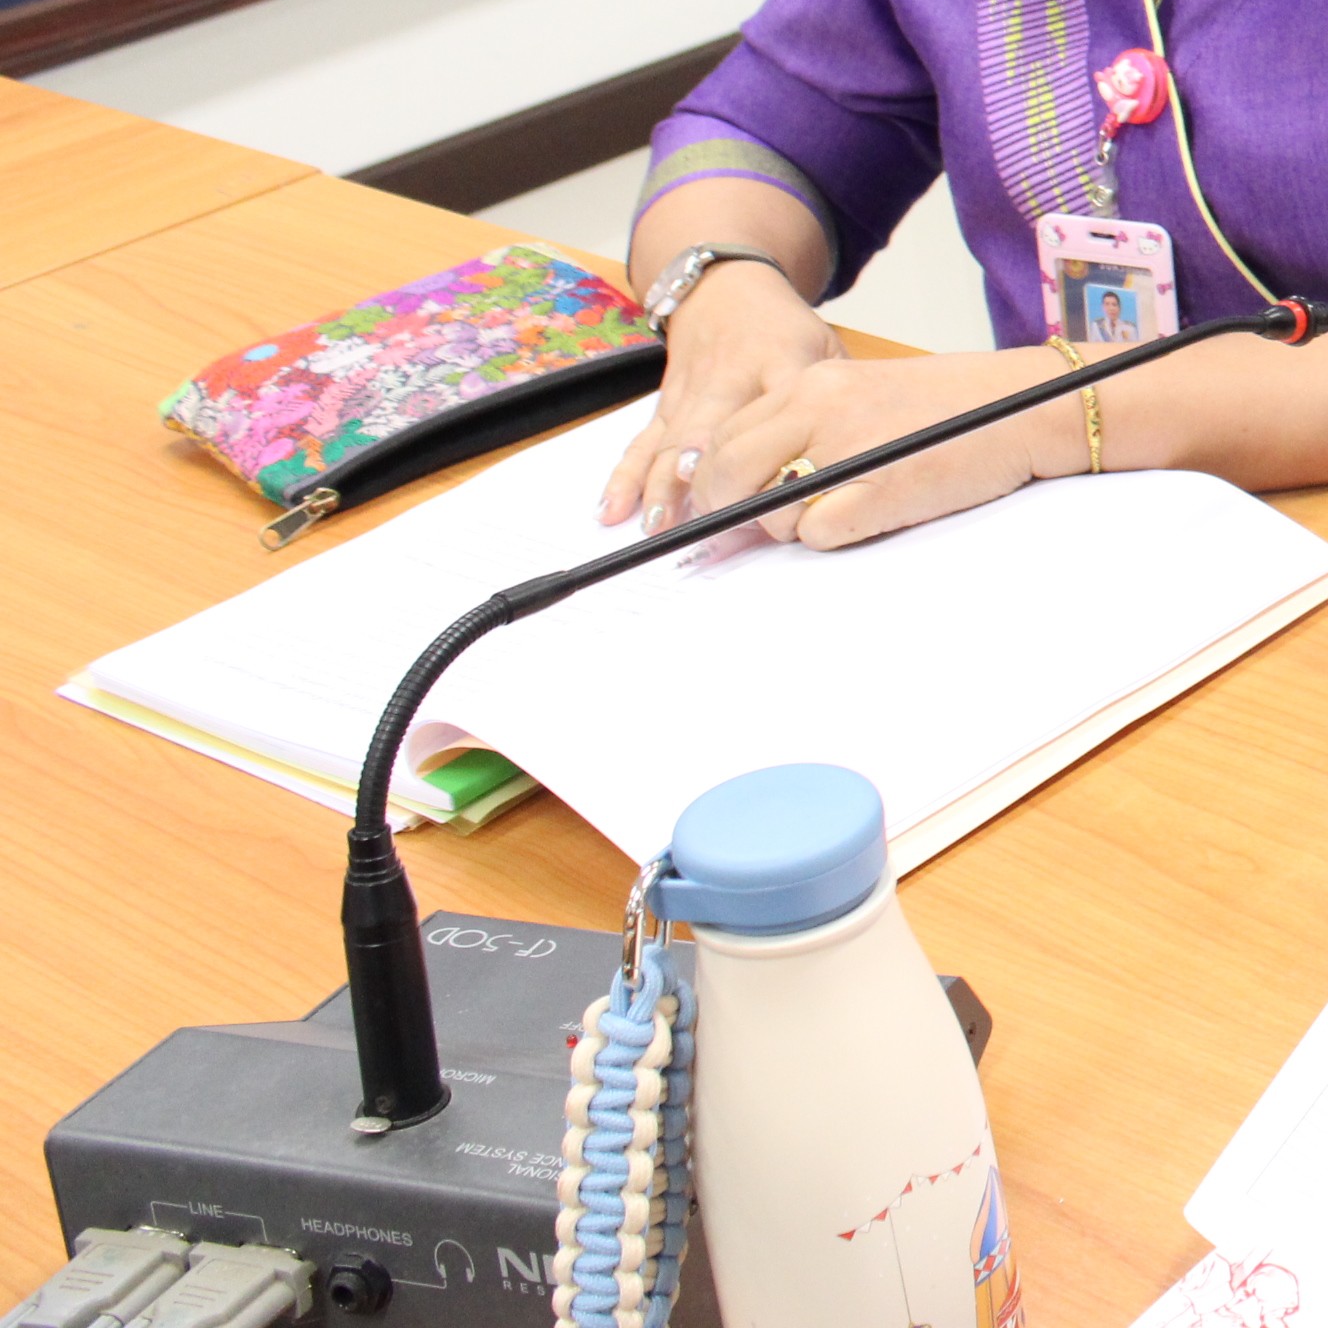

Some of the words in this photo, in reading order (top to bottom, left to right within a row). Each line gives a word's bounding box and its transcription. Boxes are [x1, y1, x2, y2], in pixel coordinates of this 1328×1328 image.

[440, 1069, 497, 1085] MICRO
[455, 1142, 528, 1161] SYSTEM
[188, 1201, 225, 1218] LINE
[301, 1217, 414, 1247] HEADPHONES
